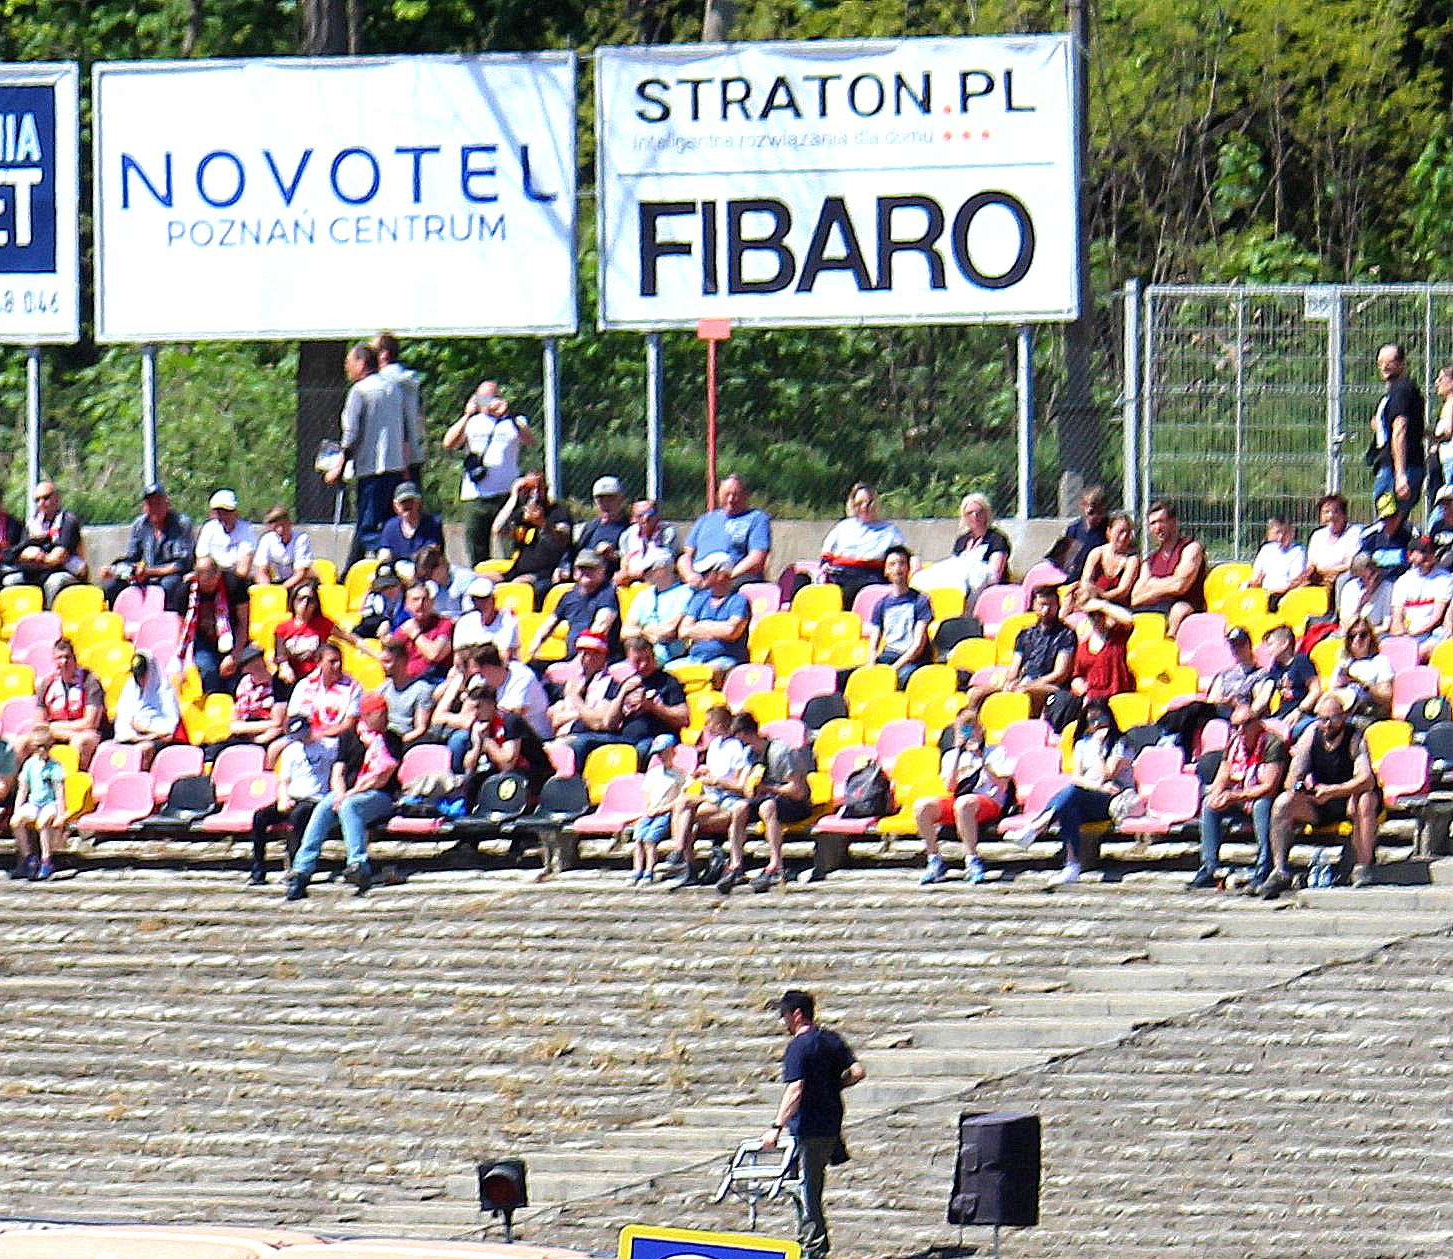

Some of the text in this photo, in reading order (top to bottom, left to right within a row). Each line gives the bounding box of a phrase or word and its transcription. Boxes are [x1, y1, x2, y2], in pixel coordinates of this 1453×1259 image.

[634, 68, 1037, 124] STRATON.PL
[120, 143, 559, 210] NOVOTEL
[167, 209, 507, 247] POZNAŃ CENTRUM
[637, 189, 1037, 298] FIBARO
